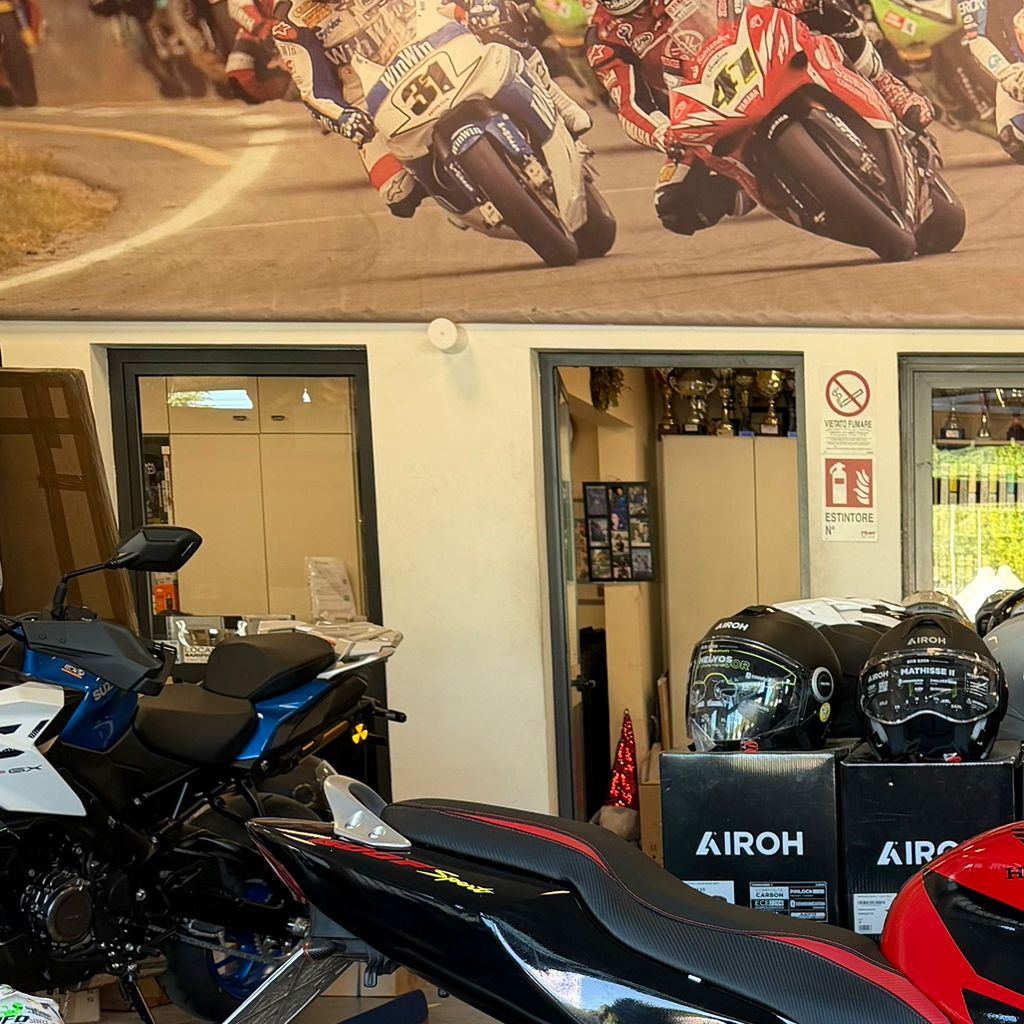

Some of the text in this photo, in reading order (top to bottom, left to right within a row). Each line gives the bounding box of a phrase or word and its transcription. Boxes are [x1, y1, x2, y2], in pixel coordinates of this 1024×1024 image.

[380, 41, 433, 89] WinWin
[400, 61, 456, 116] 31
[824, 420, 872, 429] VIETATO FUMARE
[825, 512, 875, 523] ESTINTORE
[714, 621, 749, 631] AIROH
[907, 636, 947, 645] AIROH
[868, 670, 889, 683] AIROH
[900, 667, 948, 676] MATHISSE
[695, 831, 804, 856] AIROH
